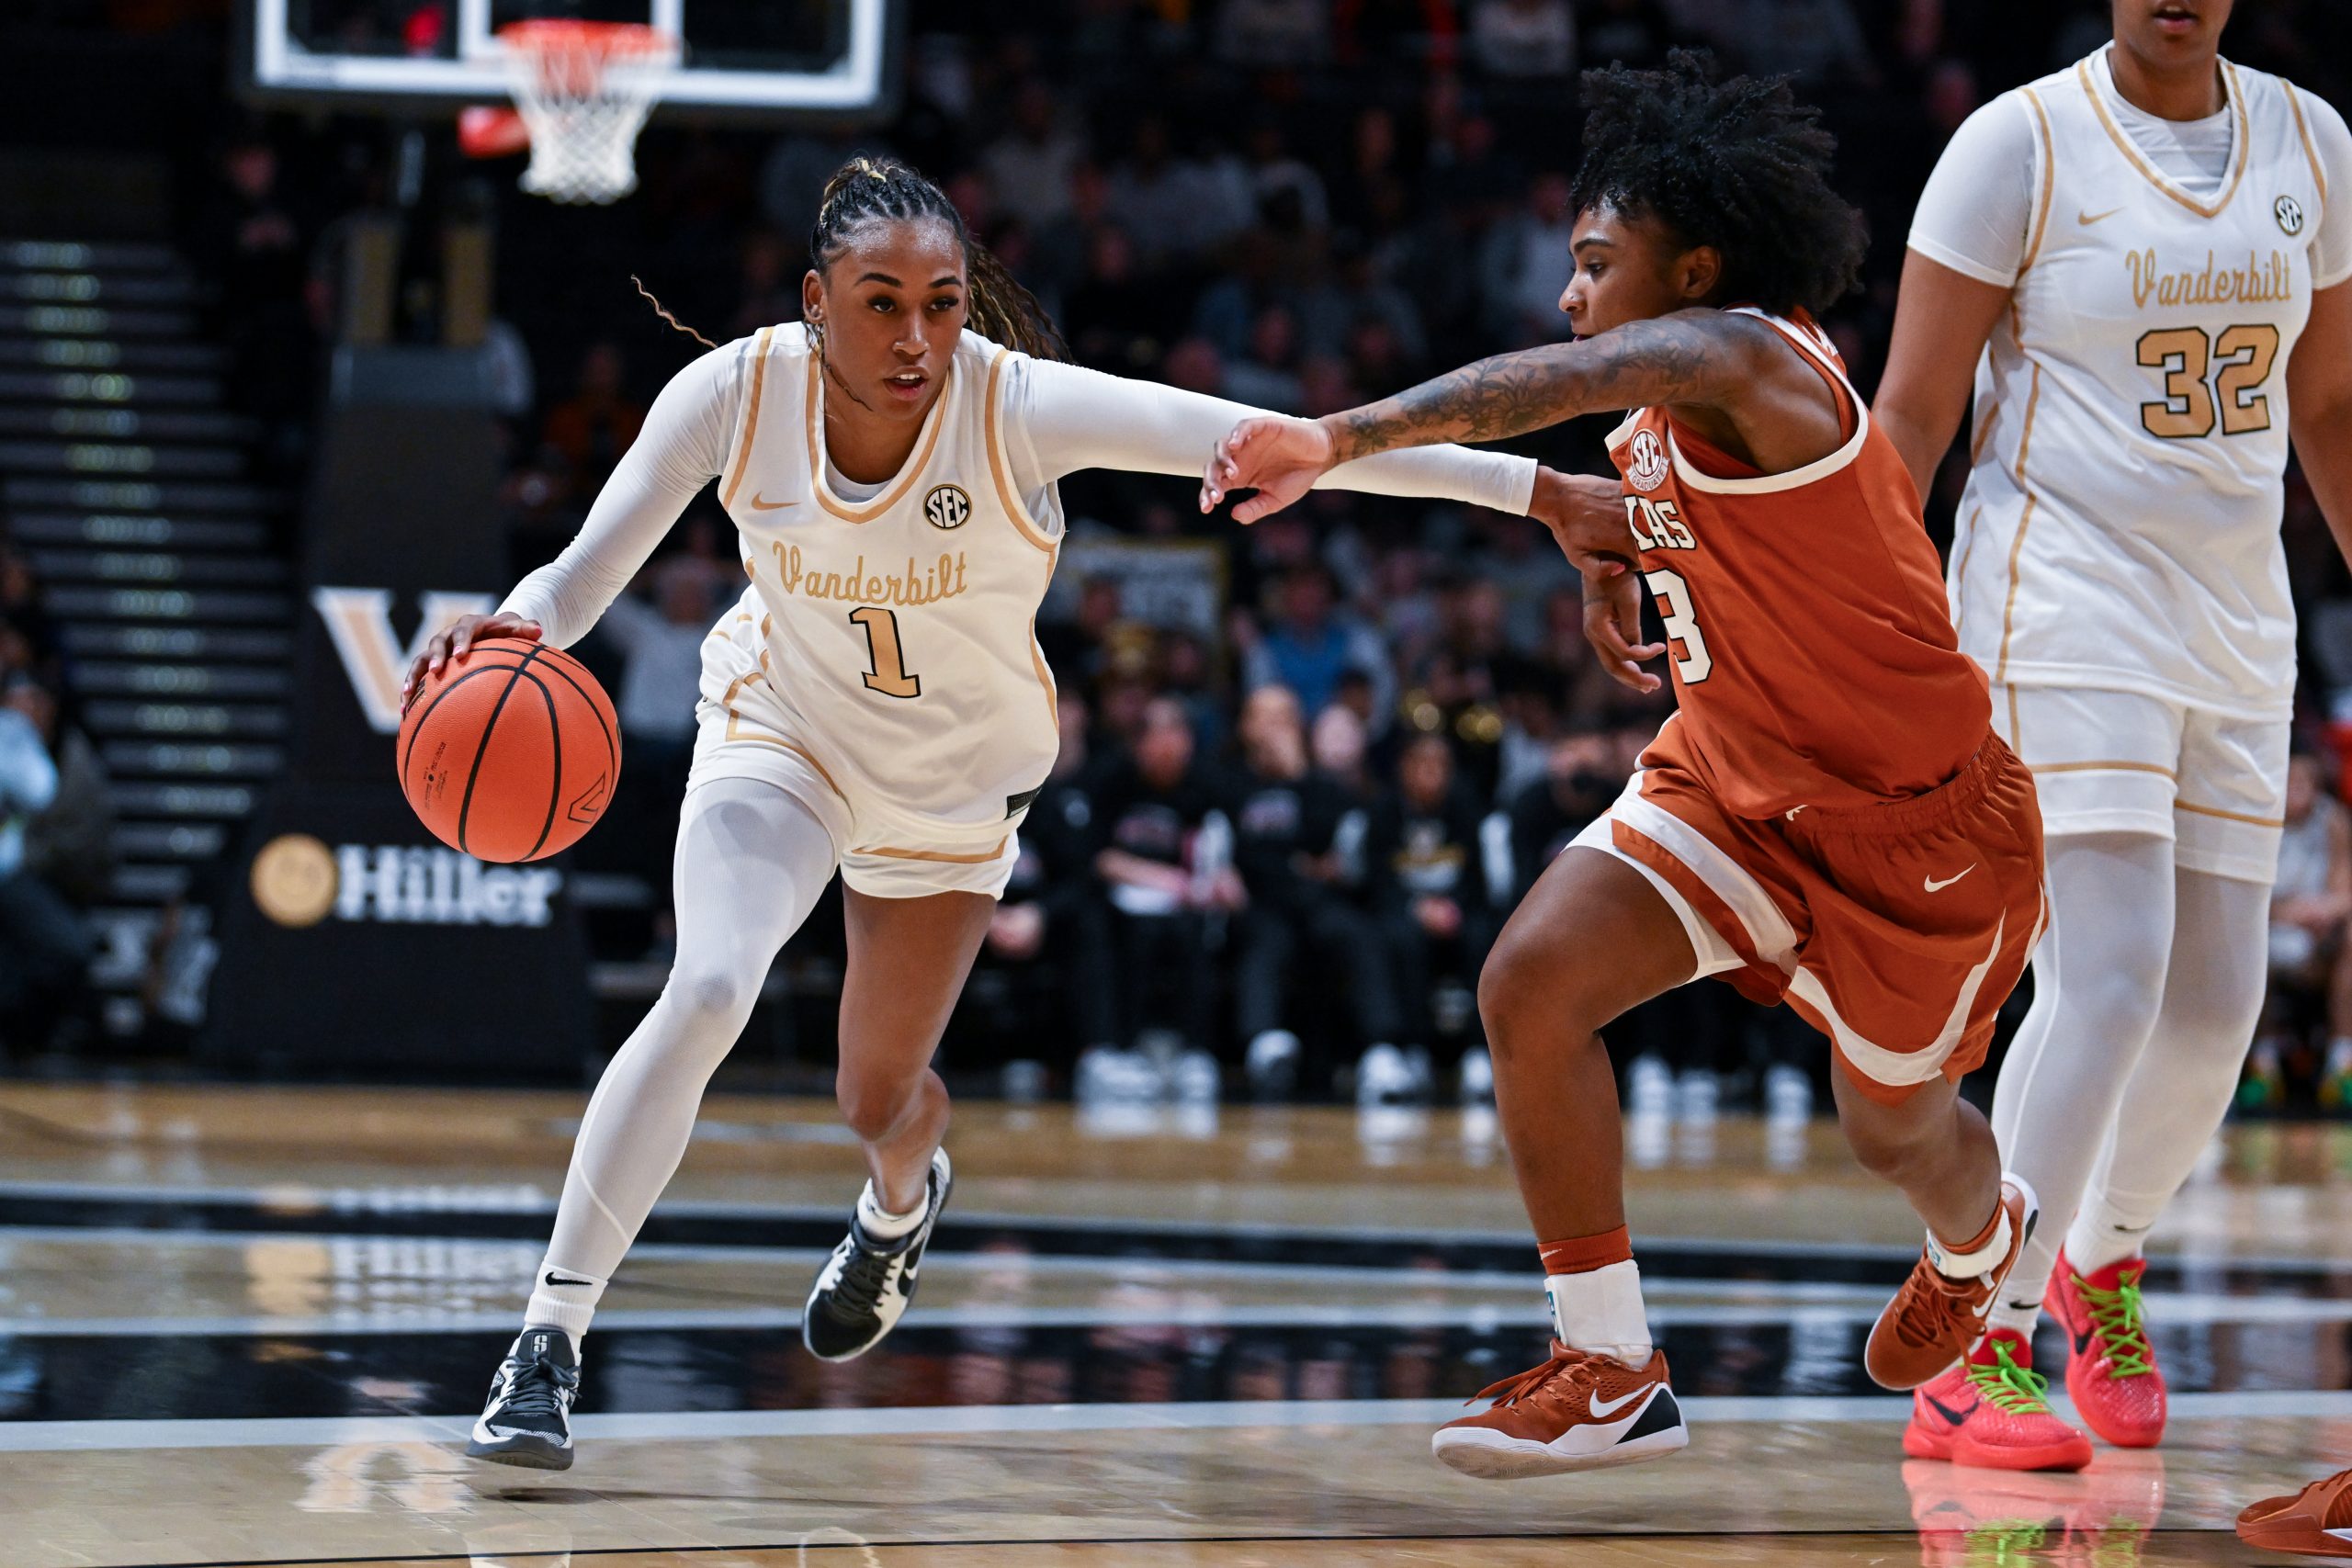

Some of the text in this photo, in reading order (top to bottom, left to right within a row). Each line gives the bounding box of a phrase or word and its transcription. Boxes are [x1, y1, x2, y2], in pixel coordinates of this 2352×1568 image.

[2276, 197, 2301, 232] SEC
[2125, 246, 2292, 310] Vanderbilt
[2136, 323, 2279, 439] 32
[1631, 467, 1666, 491] GRADUATE
[1633, 433, 1660, 476] SEC
[926, 488, 968, 528] SEC
[773, 540, 967, 606] Vanderbilt
[848, 606, 922, 699] 1
[1645, 568, 1713, 685] 3
[334, 842, 562, 925] Hiller
